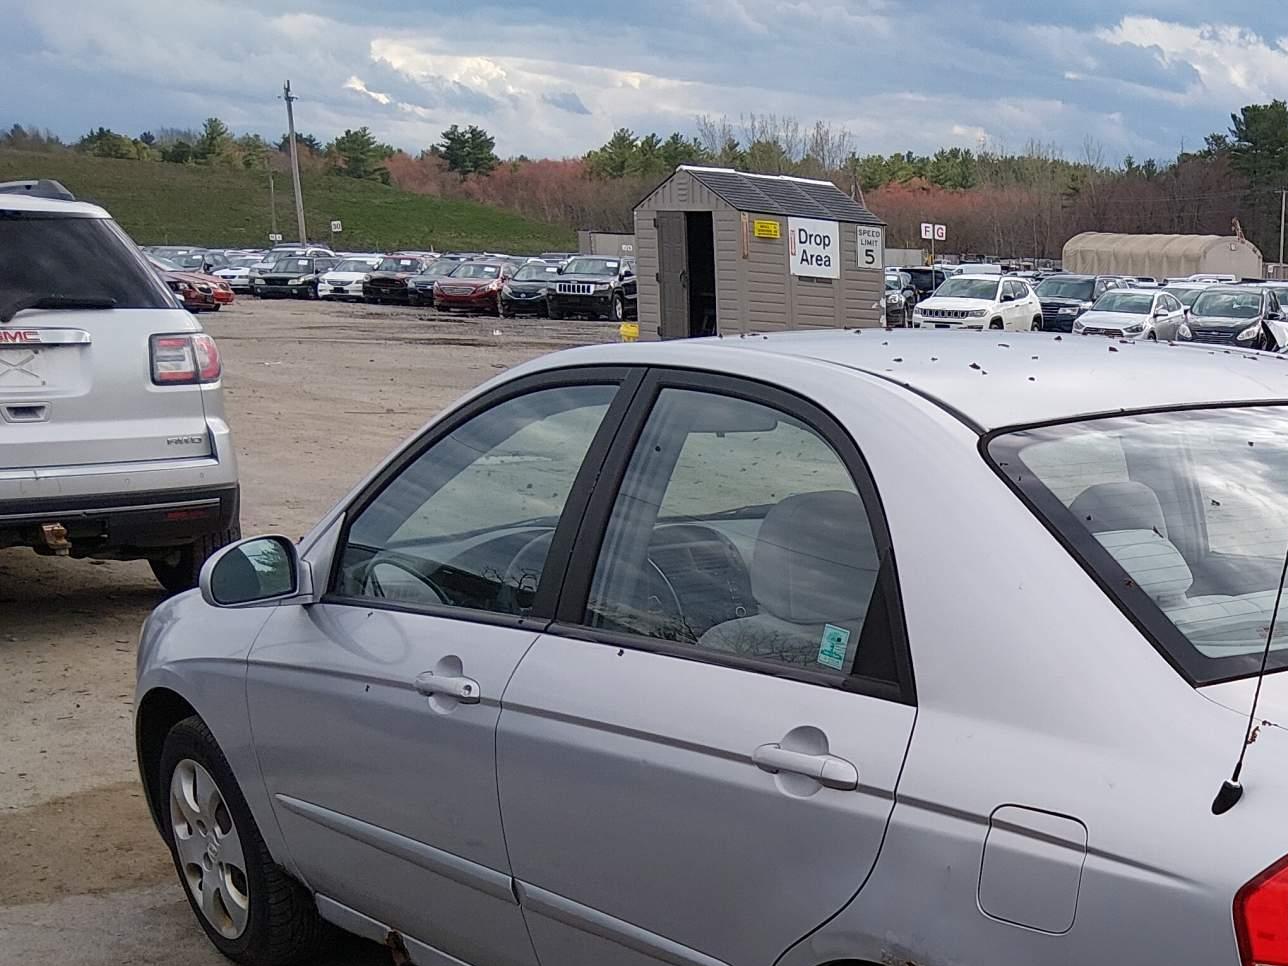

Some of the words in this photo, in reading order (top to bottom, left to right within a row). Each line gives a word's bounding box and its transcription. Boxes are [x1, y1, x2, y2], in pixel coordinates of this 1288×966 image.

[798, 228, 831, 250] Drop
[858, 229, 881, 238] SPEED
[924, 226, 930, 237] F
[937, 227, 944, 238] G
[860, 239, 878, 247] LIMIT
[800, 249, 831, 268] Area
[864, 249, 875, 265] 5
